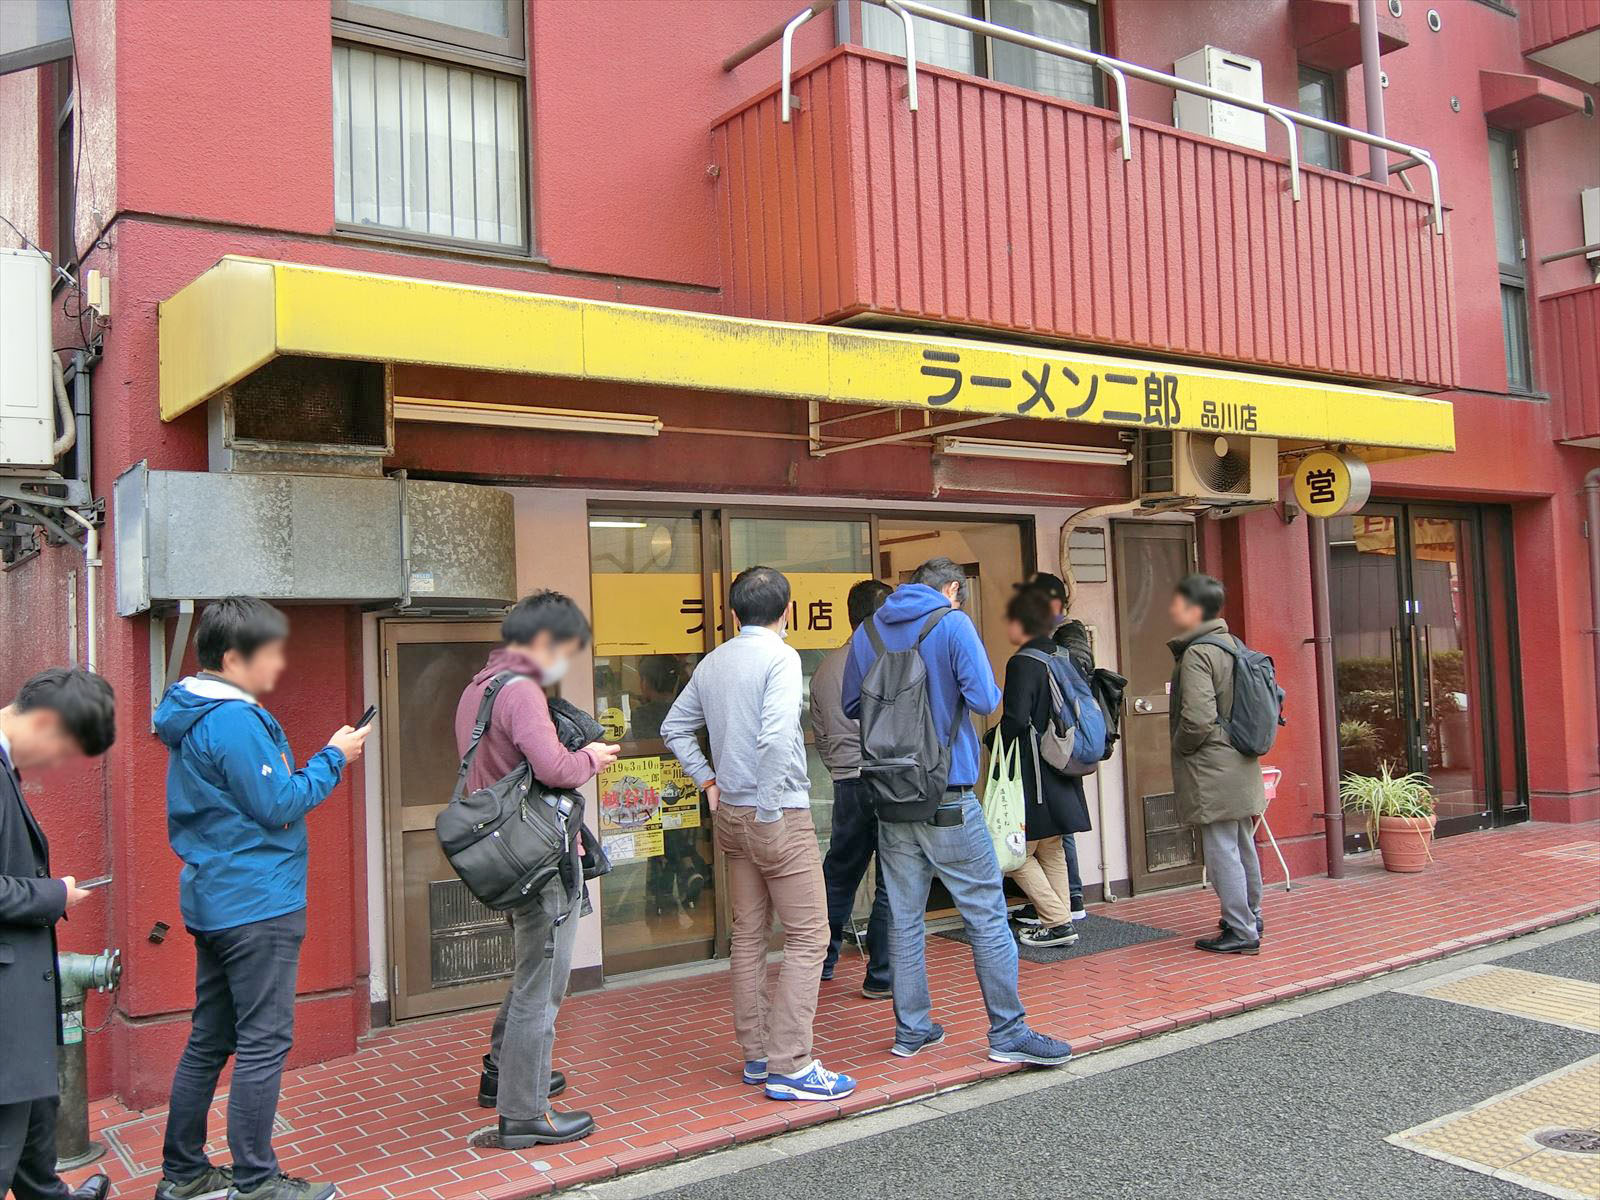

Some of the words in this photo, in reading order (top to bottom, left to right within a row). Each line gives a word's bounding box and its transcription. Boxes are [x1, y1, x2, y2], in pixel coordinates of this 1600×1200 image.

[920, 349, 1180, 429] ラーメン二郎
[1200, 400, 1258, 432] 品川店
[1305, 468, 1337, 504] 営
